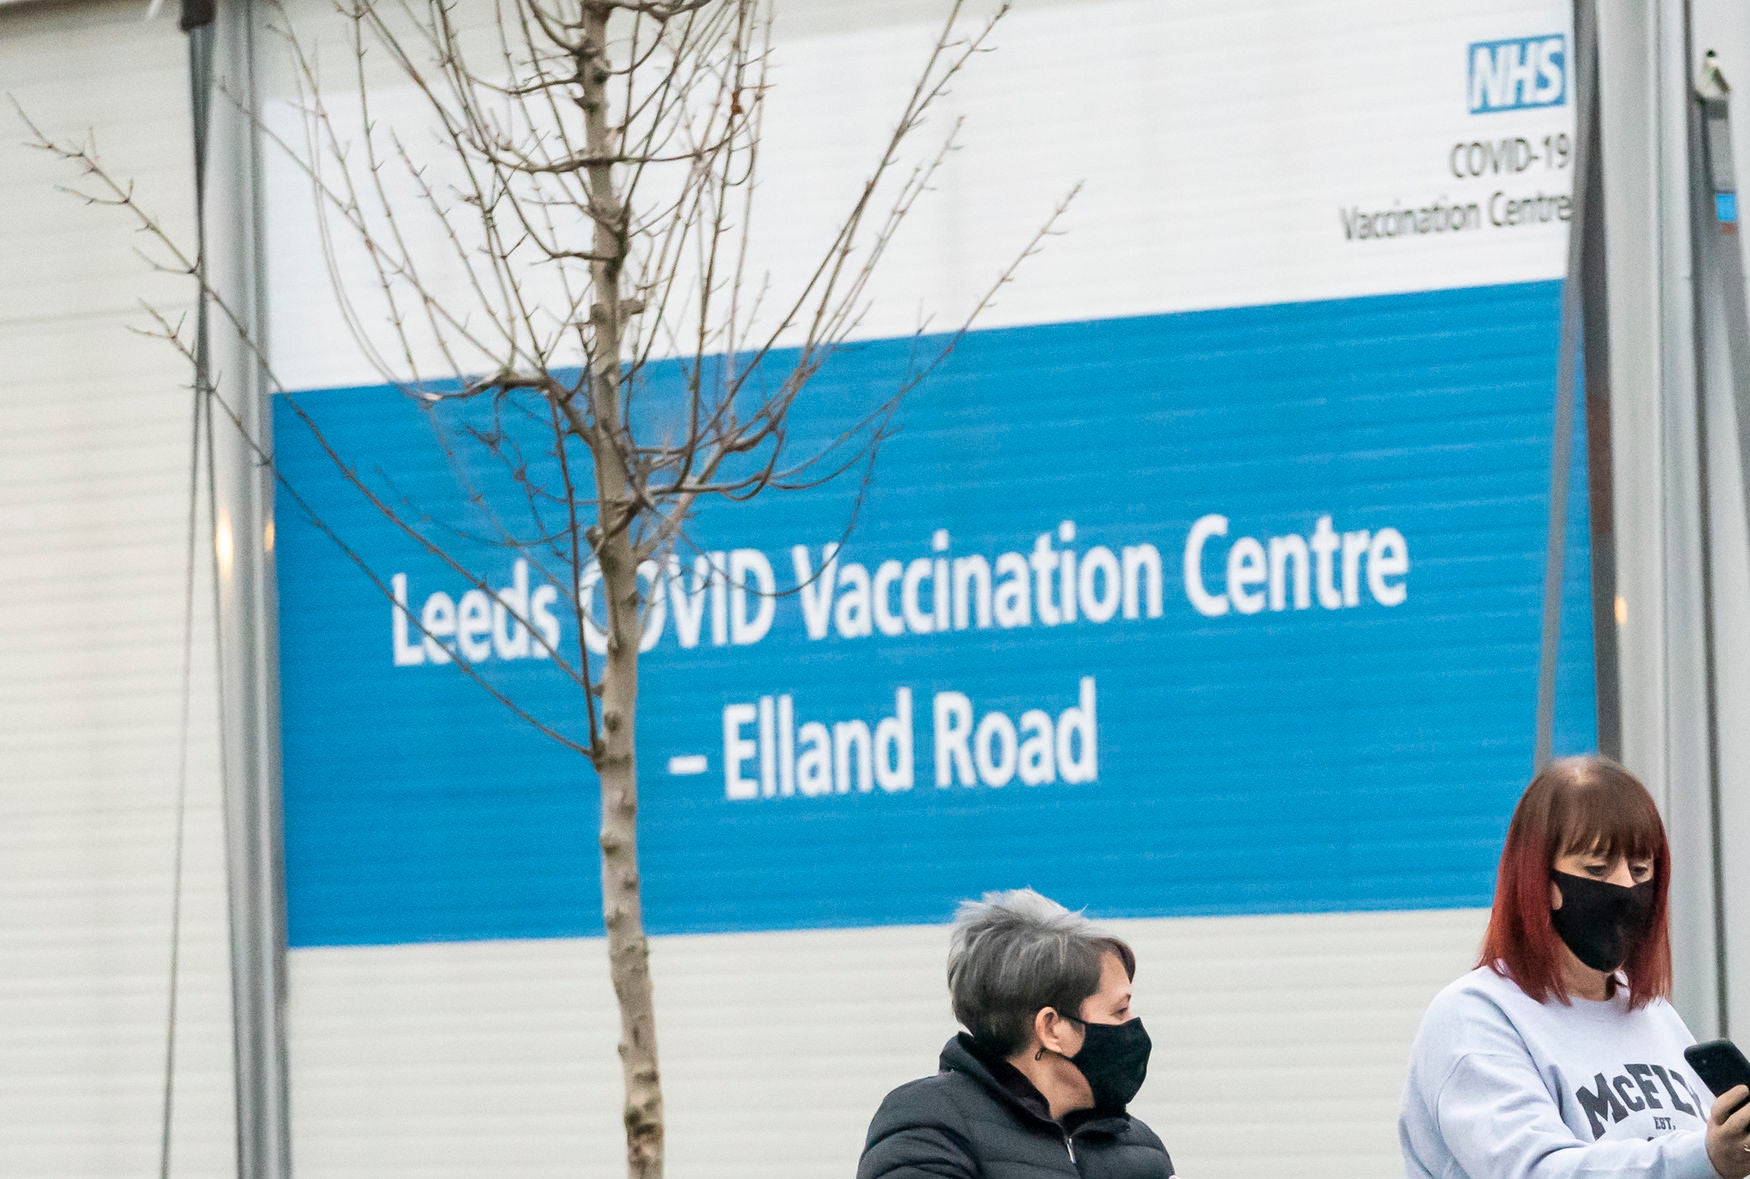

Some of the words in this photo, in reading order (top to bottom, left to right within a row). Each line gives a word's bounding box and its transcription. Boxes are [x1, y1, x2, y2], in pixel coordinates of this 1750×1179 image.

[1470, 36, 1565, 112] NHS
[1450, 133, 1571, 179] COVID-19
[1339, 197, 1481, 241] Vaccination
[1488, 189, 1571, 229] Centre
[391, 557, 560, 667] Leeds
[792, 519, 1163, 641] Vaccination
[1184, 514, 1409, 617] Centre
[723, 687, 915, 801] Elland
[933, 676, 1098, 789] Road
